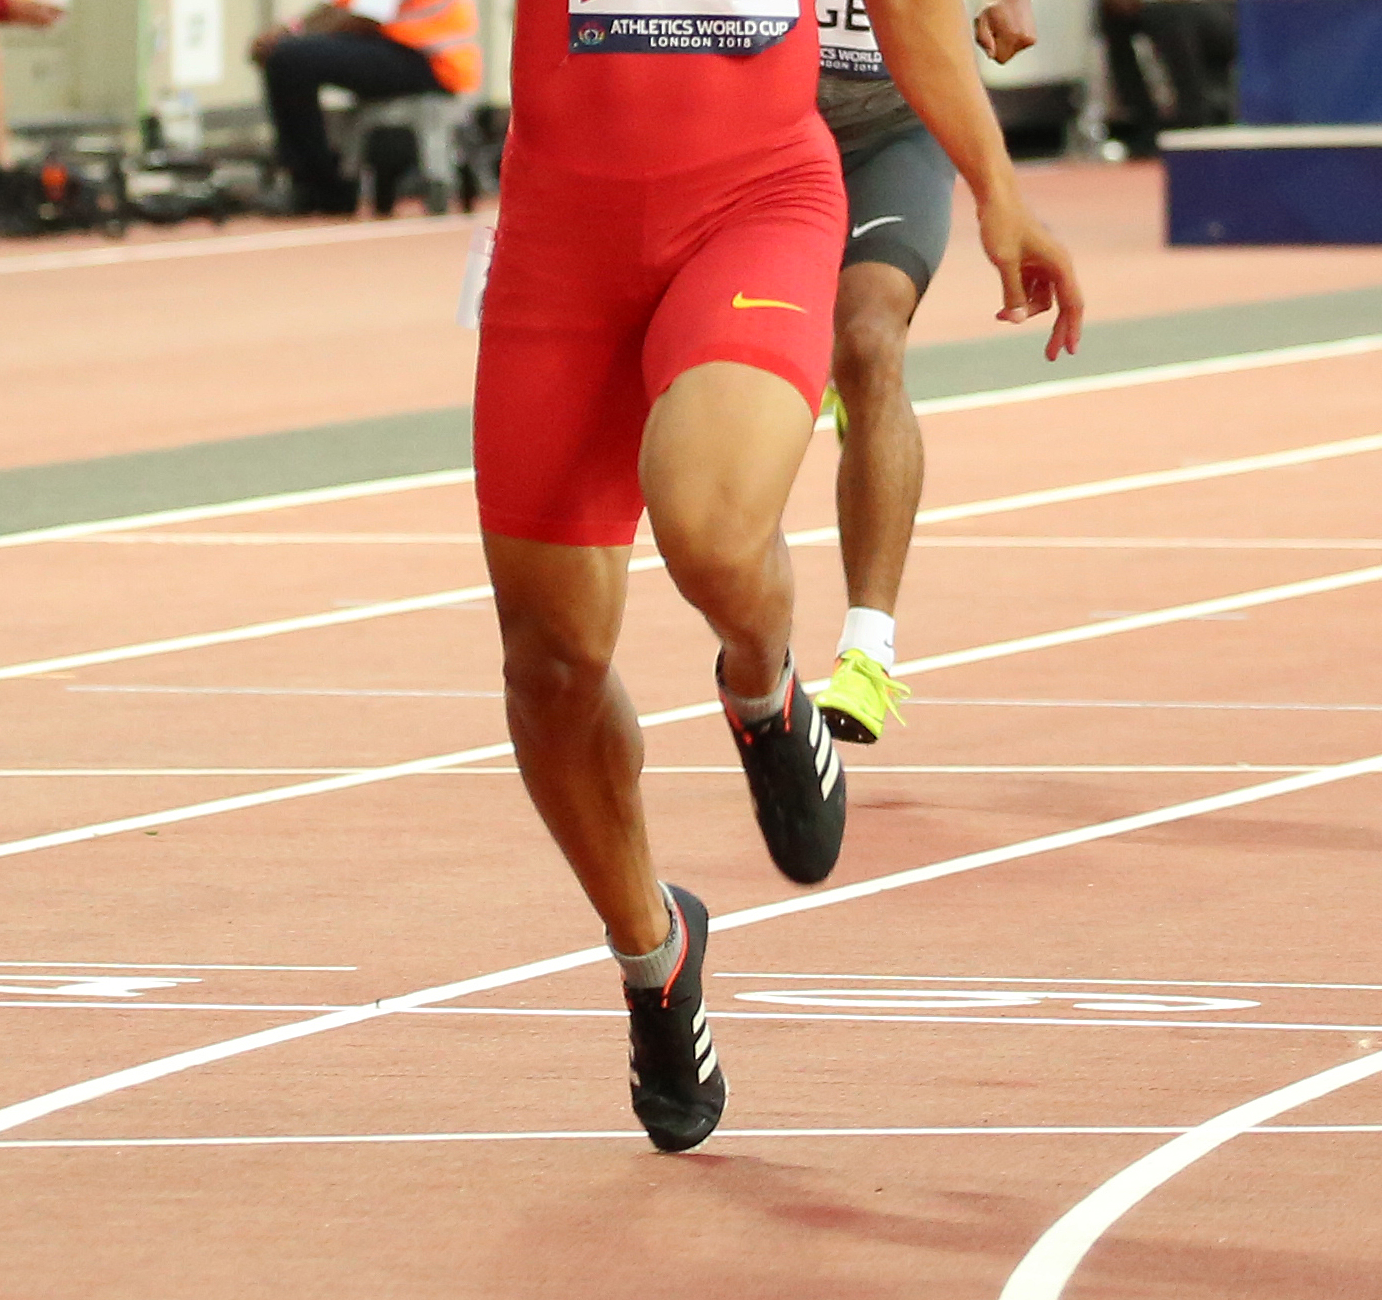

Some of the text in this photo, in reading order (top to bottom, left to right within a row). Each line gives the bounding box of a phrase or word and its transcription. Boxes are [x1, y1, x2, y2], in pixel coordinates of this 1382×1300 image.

[610, 18, 790, 37] ATHLETICS WORLD CUP
[649, 36, 752, 49] LONDON 2018
